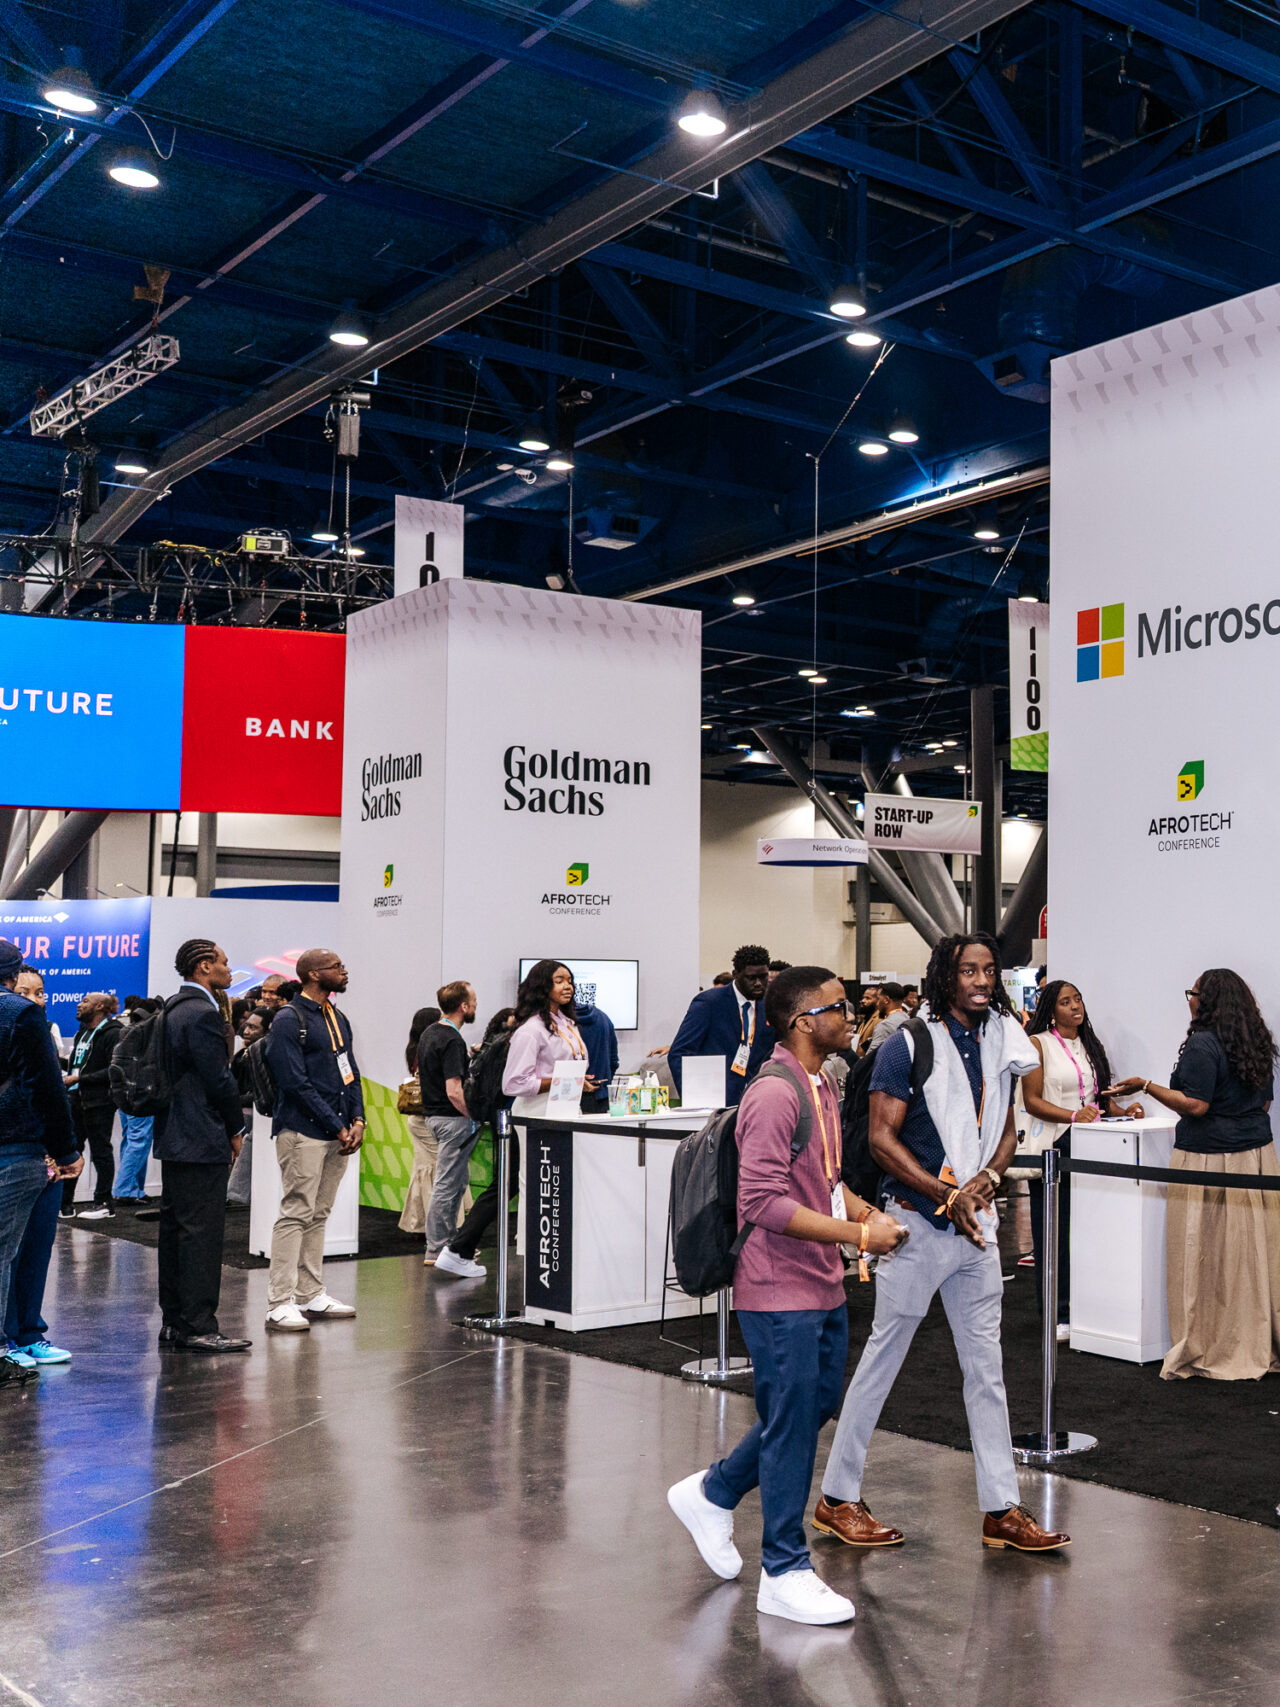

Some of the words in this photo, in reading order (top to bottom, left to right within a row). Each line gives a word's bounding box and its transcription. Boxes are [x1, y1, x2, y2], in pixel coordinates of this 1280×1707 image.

[1026, 625, 1041, 731] 1100
[0, 687, 113, 716] UTURE
[245, 717, 334, 741] BANK
[362, 752, 422, 791] Goldman
[504, 745, 651, 787] Goldman
[361, 787, 401, 822] Sachs
[504, 776, 605, 817] Sachs
[874, 806, 934, 825] START-UP
[1147, 811, 1234, 837] AFROTECH
[874, 824, 903, 839] ROW
[1157, 836, 1221, 852] CONFERENCE
[812, 843, 842, 852] Network
[373, 895, 403, 908] AFROTECH
[541, 893, 611, 906] AFROTECH
[549, 907, 601, 916] CONFERENCE
[3, 915, 16, 923] OF
[16, 915, 53, 923] AMERICA
[62, 933, 141, 959] FUTURE
[49, 968, 60, 976] OF
[61, 968, 92, 976] AMERICA
[538, 1140, 551, 1289] AFROTECH
[552, 1165, 560, 1272] CONFERENCE
